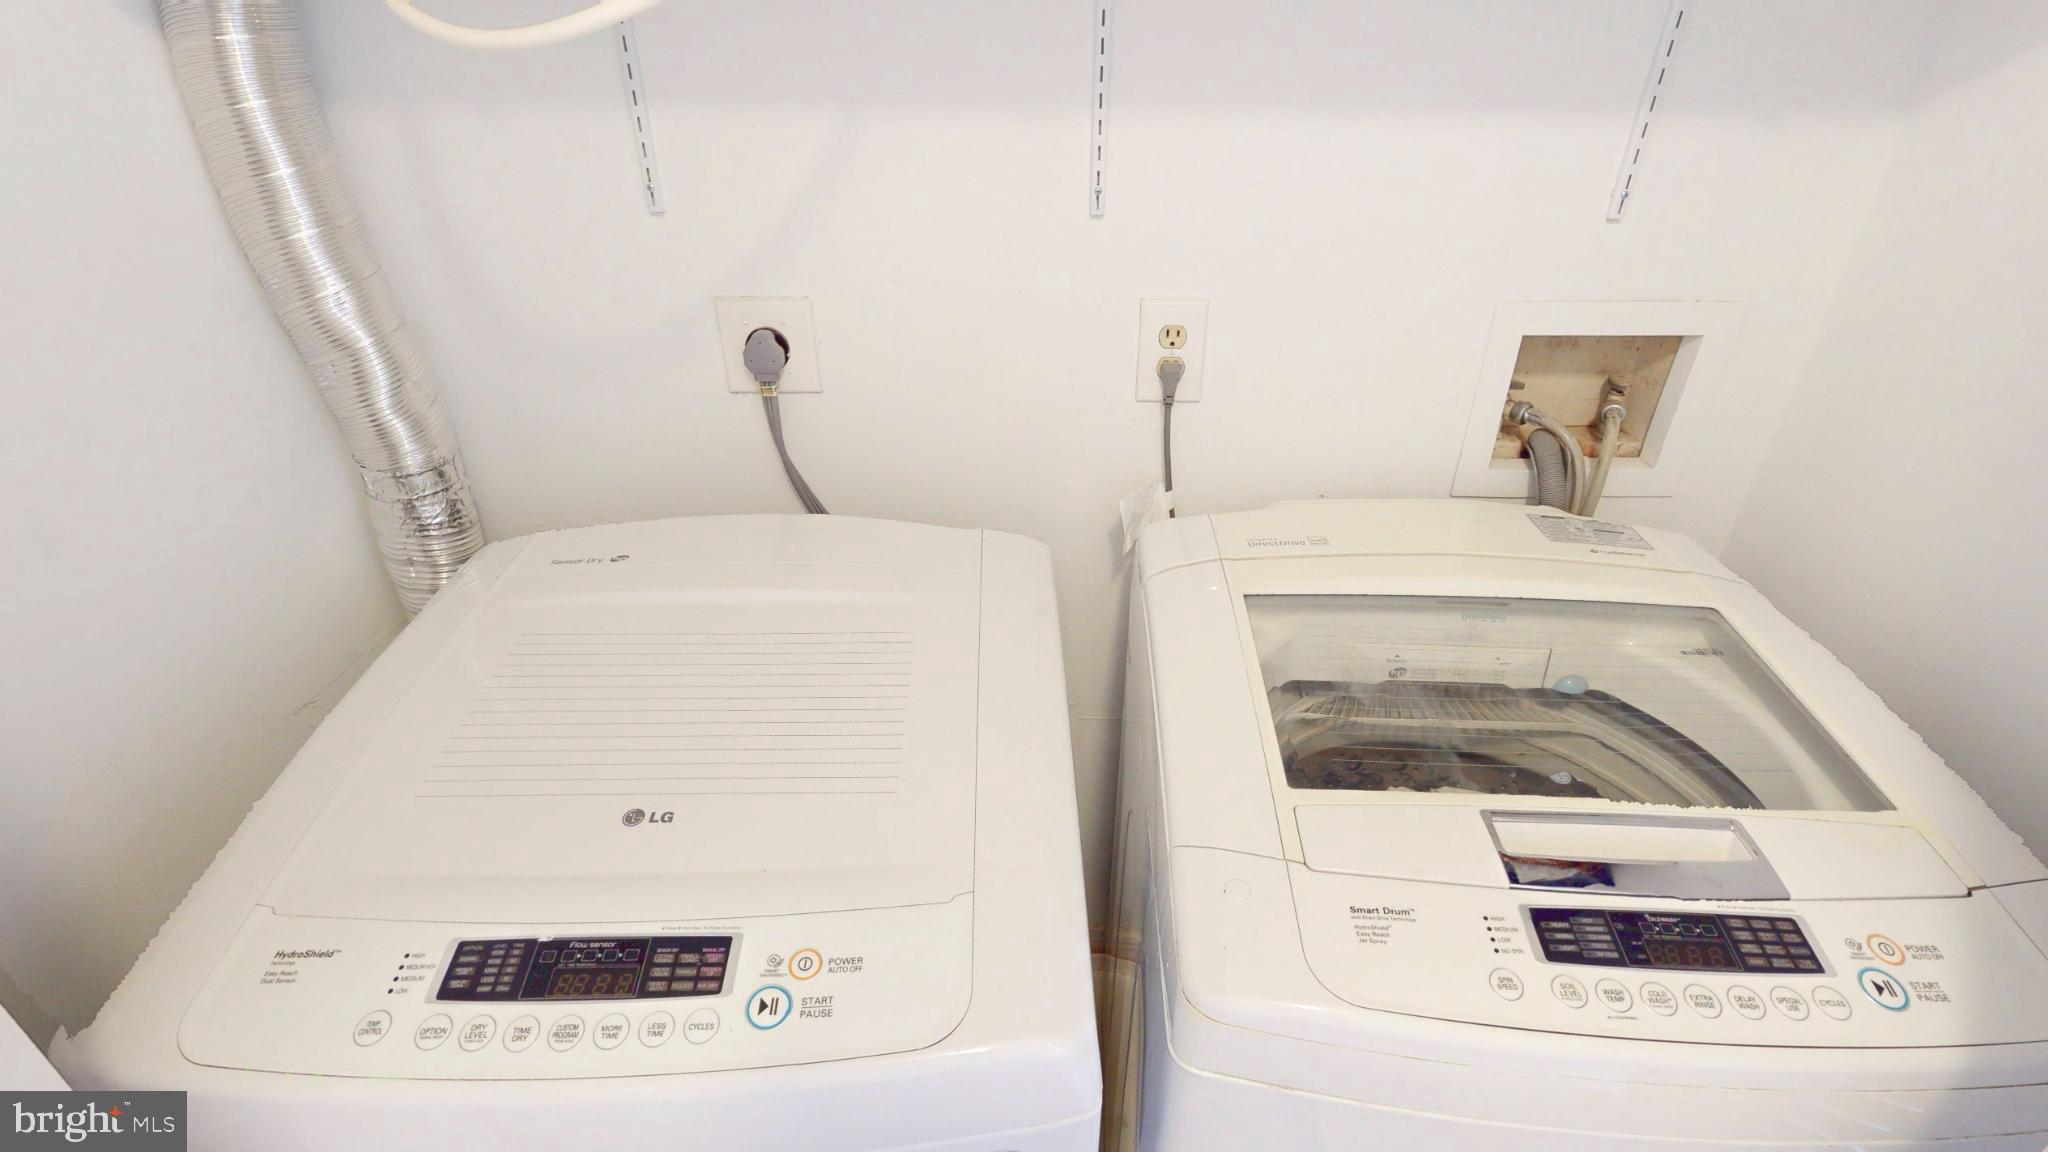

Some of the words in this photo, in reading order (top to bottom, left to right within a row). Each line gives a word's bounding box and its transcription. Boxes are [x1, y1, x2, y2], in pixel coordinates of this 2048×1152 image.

[649, 811, 674, 823] LG
[1350, 906, 1379, 914] Smart
[1904, 945, 1940, 953] POWER
[829, 956, 864, 965] POWER
[849, 965, 864, 973] OFF
[1909, 981, 1939, 990] START
[1560, 990, 1583, 998] LEVEL
[1916, 993, 1952, 1002] PAUSE
[801, 997, 833, 1006] START
[800, 1009, 833, 1018] PAUSE
[647, 1022, 667, 1030] LESS
[688, 1023, 714, 1031] CYCLES
[419, 1027, 447, 1035] OPTION
[552, 1031, 579, 1039] PROGRAM
[512, 1034, 528, 1042] DRY
[601, 1032, 620, 1040] TIME
